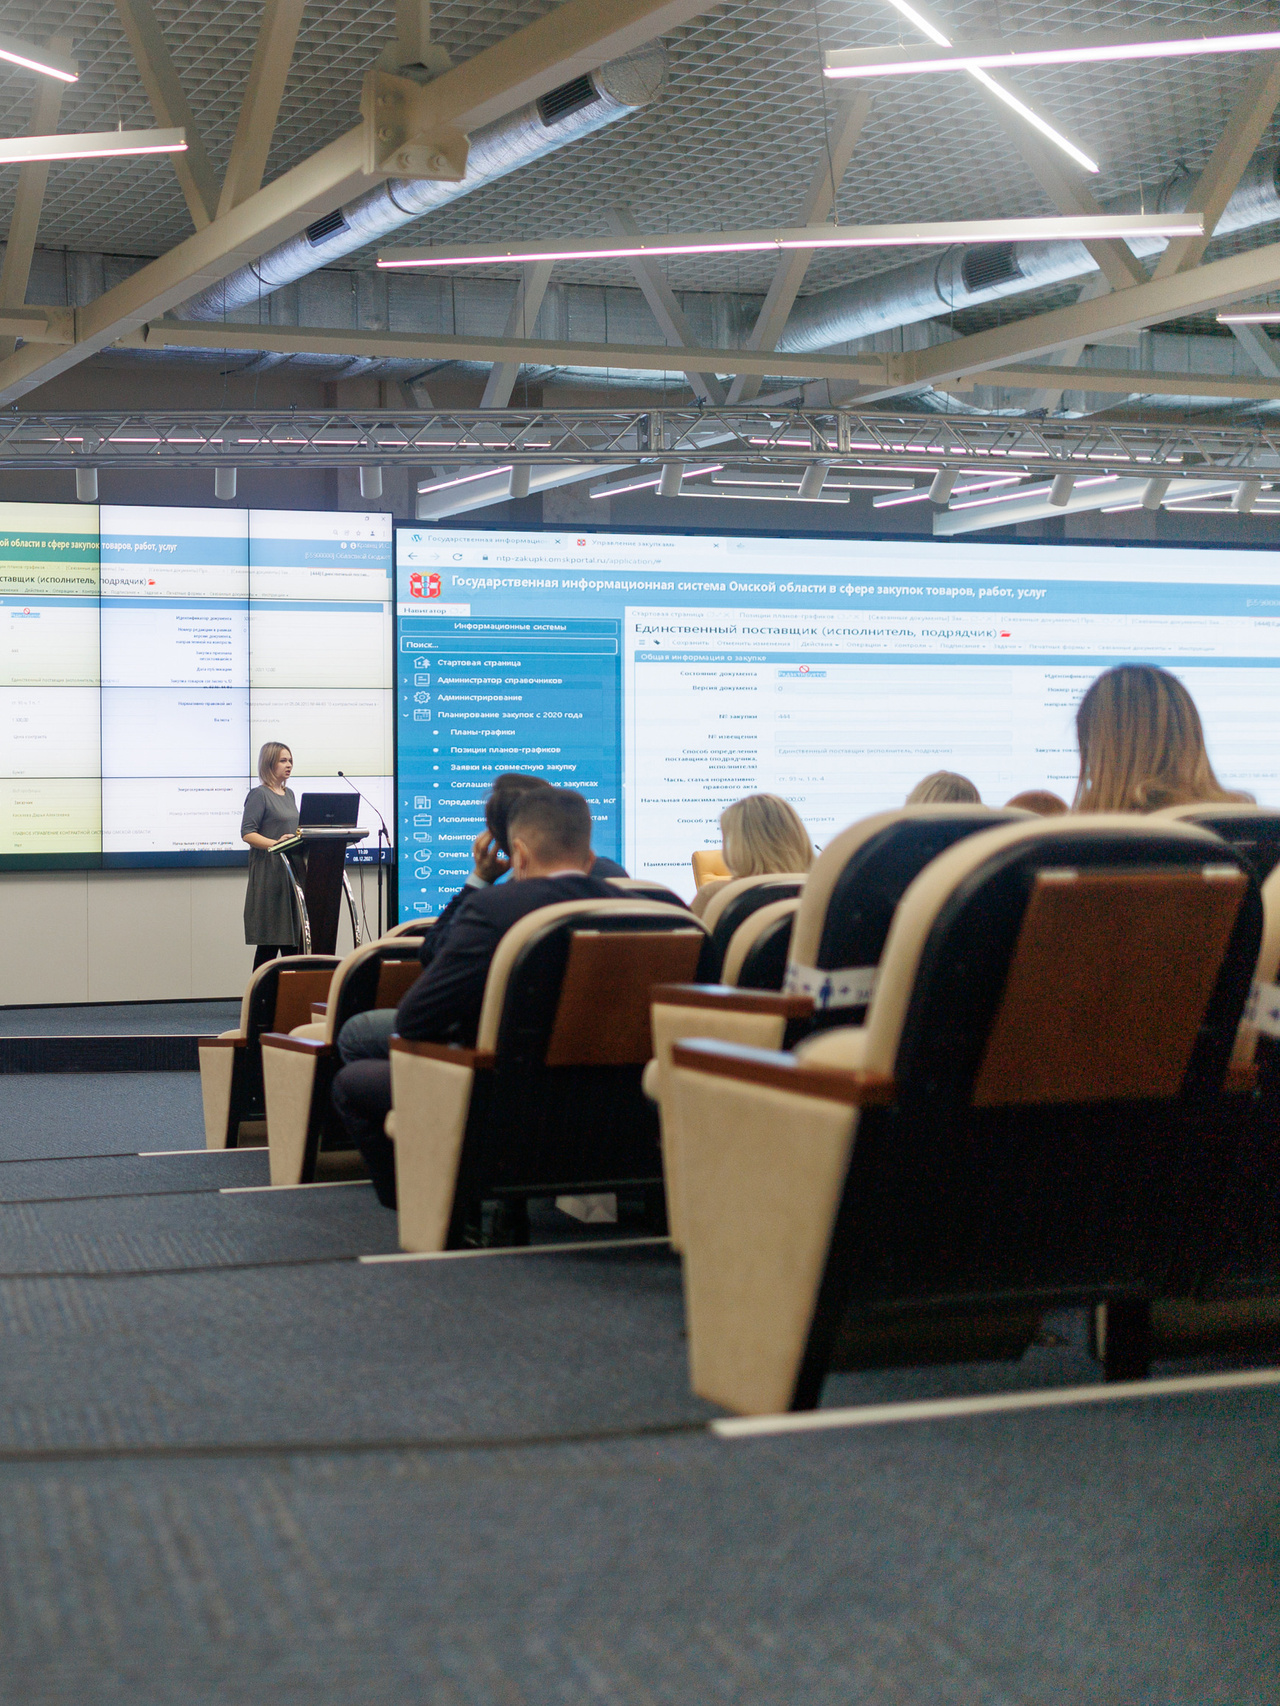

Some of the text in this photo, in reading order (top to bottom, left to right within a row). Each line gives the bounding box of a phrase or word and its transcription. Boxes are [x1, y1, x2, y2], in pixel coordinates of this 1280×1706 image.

[11, 538, 40, 548] области
[48, 539, 69, 550] сфере
[71, 542, 100, 551] закупок
[102, 542, 133, 552] товаров,
[134, 542, 157, 552] работ,
[159, 543, 177, 553] услуг
[38, 575, 96, 585] (исполнитель,
[452, 575, 1047, 600] Государственная информационная система Омской области в сфере закупок товаров, работ, услуг
[454, 622, 567, 631] Информационные системы
[635, 624, 997, 639] Единственный поставщик (исполнитель, подрядчик)
[406, 641, 439, 649] Поиск...
[672, 654, 725, 662] информация
[735, 654, 767, 662] закупке
[438, 659, 521, 668] Стартовая страница
[438, 677, 502, 685] Администратор
[438, 694, 523, 702] Администрирование
[438, 712, 500, 720] Планирование
[502, 712, 534, 720] закупок
[451, 729, 515, 737] Планы-графики
[451, 746, 561, 754] Позиции планов-графиков
[451, 781, 494, 789] Соглашен
[438, 851, 469, 859] Отчеты
